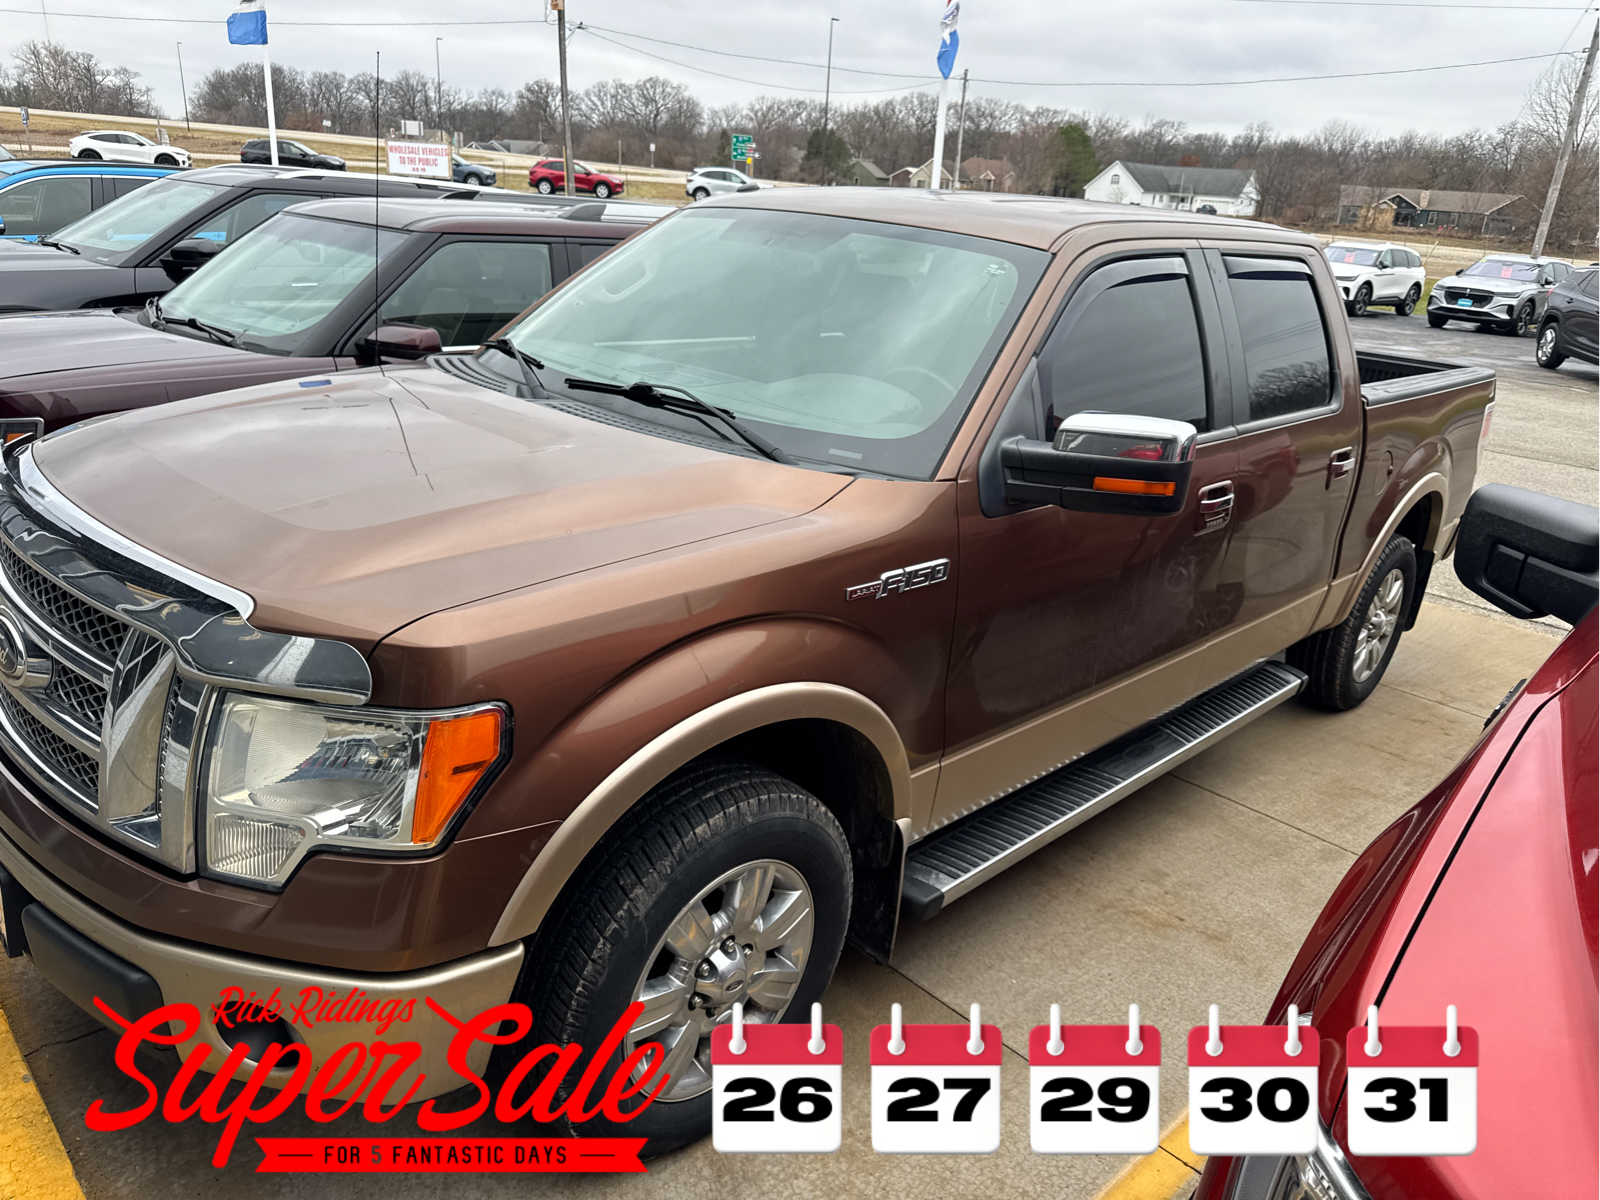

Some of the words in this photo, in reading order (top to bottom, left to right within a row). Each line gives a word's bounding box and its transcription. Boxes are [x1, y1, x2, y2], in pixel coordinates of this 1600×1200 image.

[389, 145, 420, 155] WHOLESALE
[421, 147, 449, 157] VEHICLES
[407, 157, 417, 165] THE
[418, 157, 438, 167] PUBLIC
